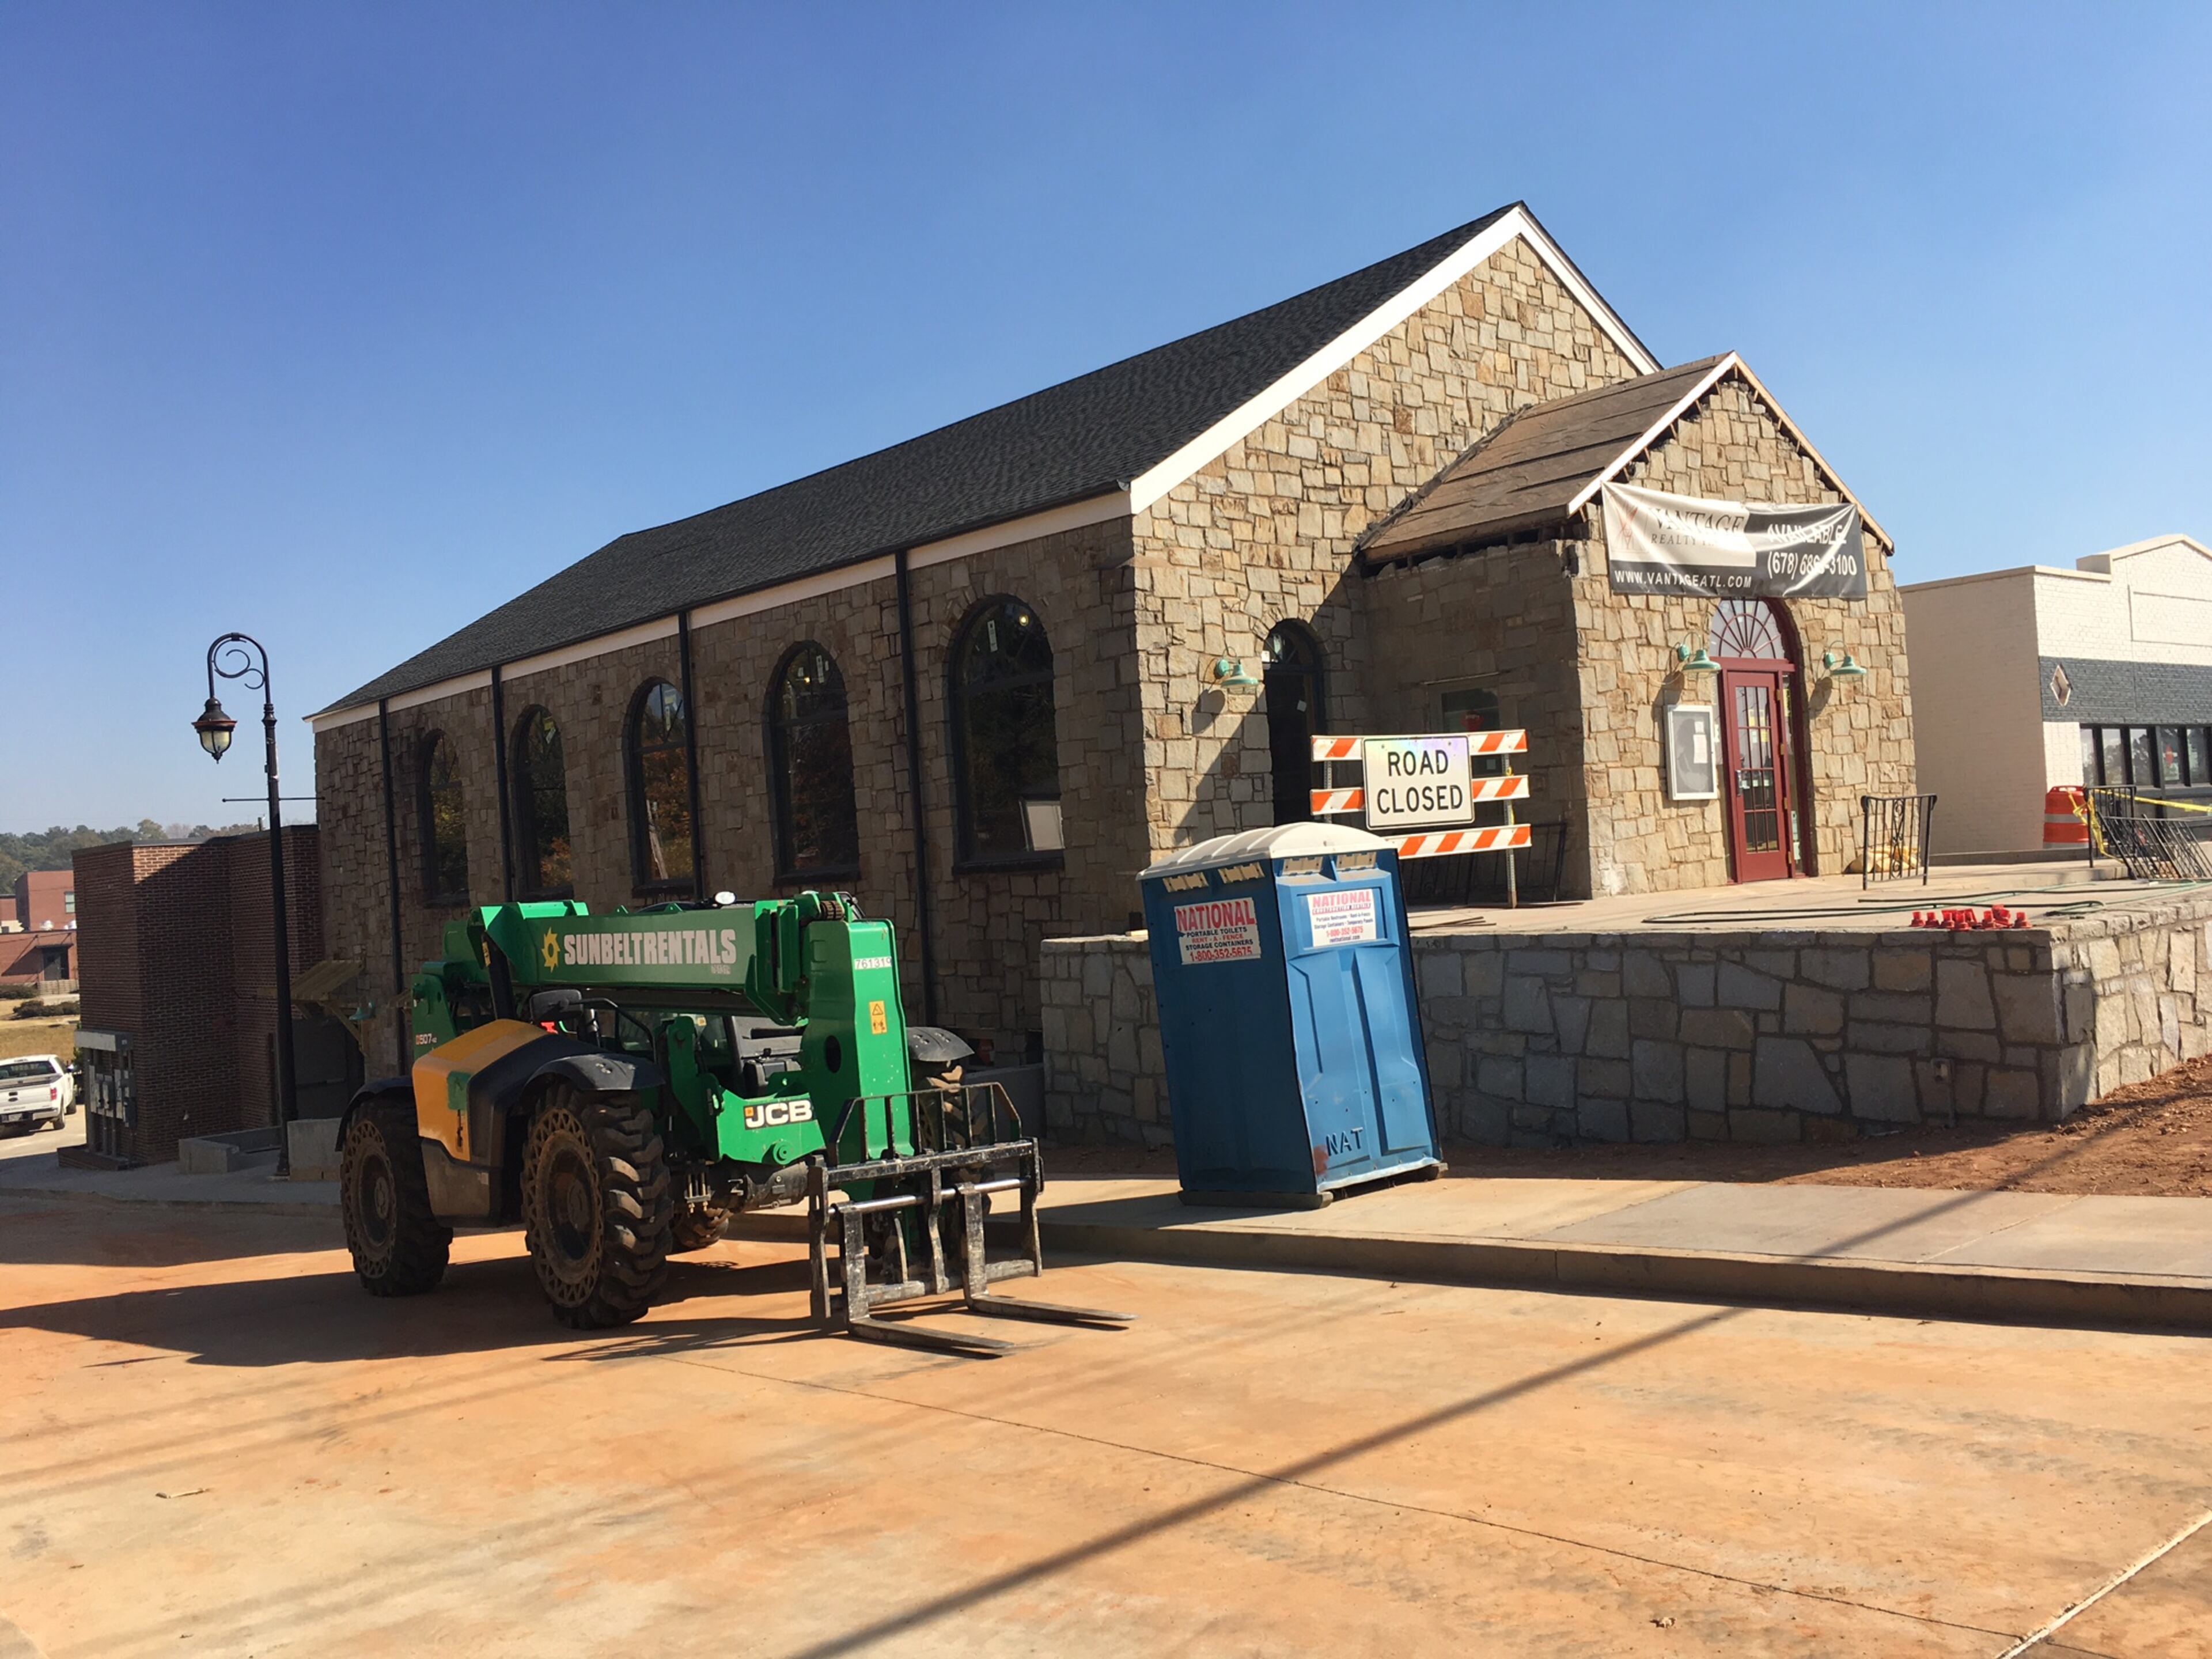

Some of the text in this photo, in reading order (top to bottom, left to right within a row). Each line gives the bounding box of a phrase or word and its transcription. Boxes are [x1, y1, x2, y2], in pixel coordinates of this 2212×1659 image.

[1651, 533, 1696, 546] REALTY
[1614, 570, 1752, 588] WWW.VANTAGEATL.COM
[1767, 551, 1798, 580] (678)
[1388, 749, 1449, 777] ROAD
[1377, 785, 1463, 815] CLOSED
[1312, 891, 1371, 907] NATIONAL
[1176, 900, 1255, 931] NATIONAL
[1214, 939, 1253, 948] CONTAINERS
[855, 957, 891, 969] 761319
[745, 1100, 812, 1128] JCB
[1326, 1127, 1363, 1157] NAT
